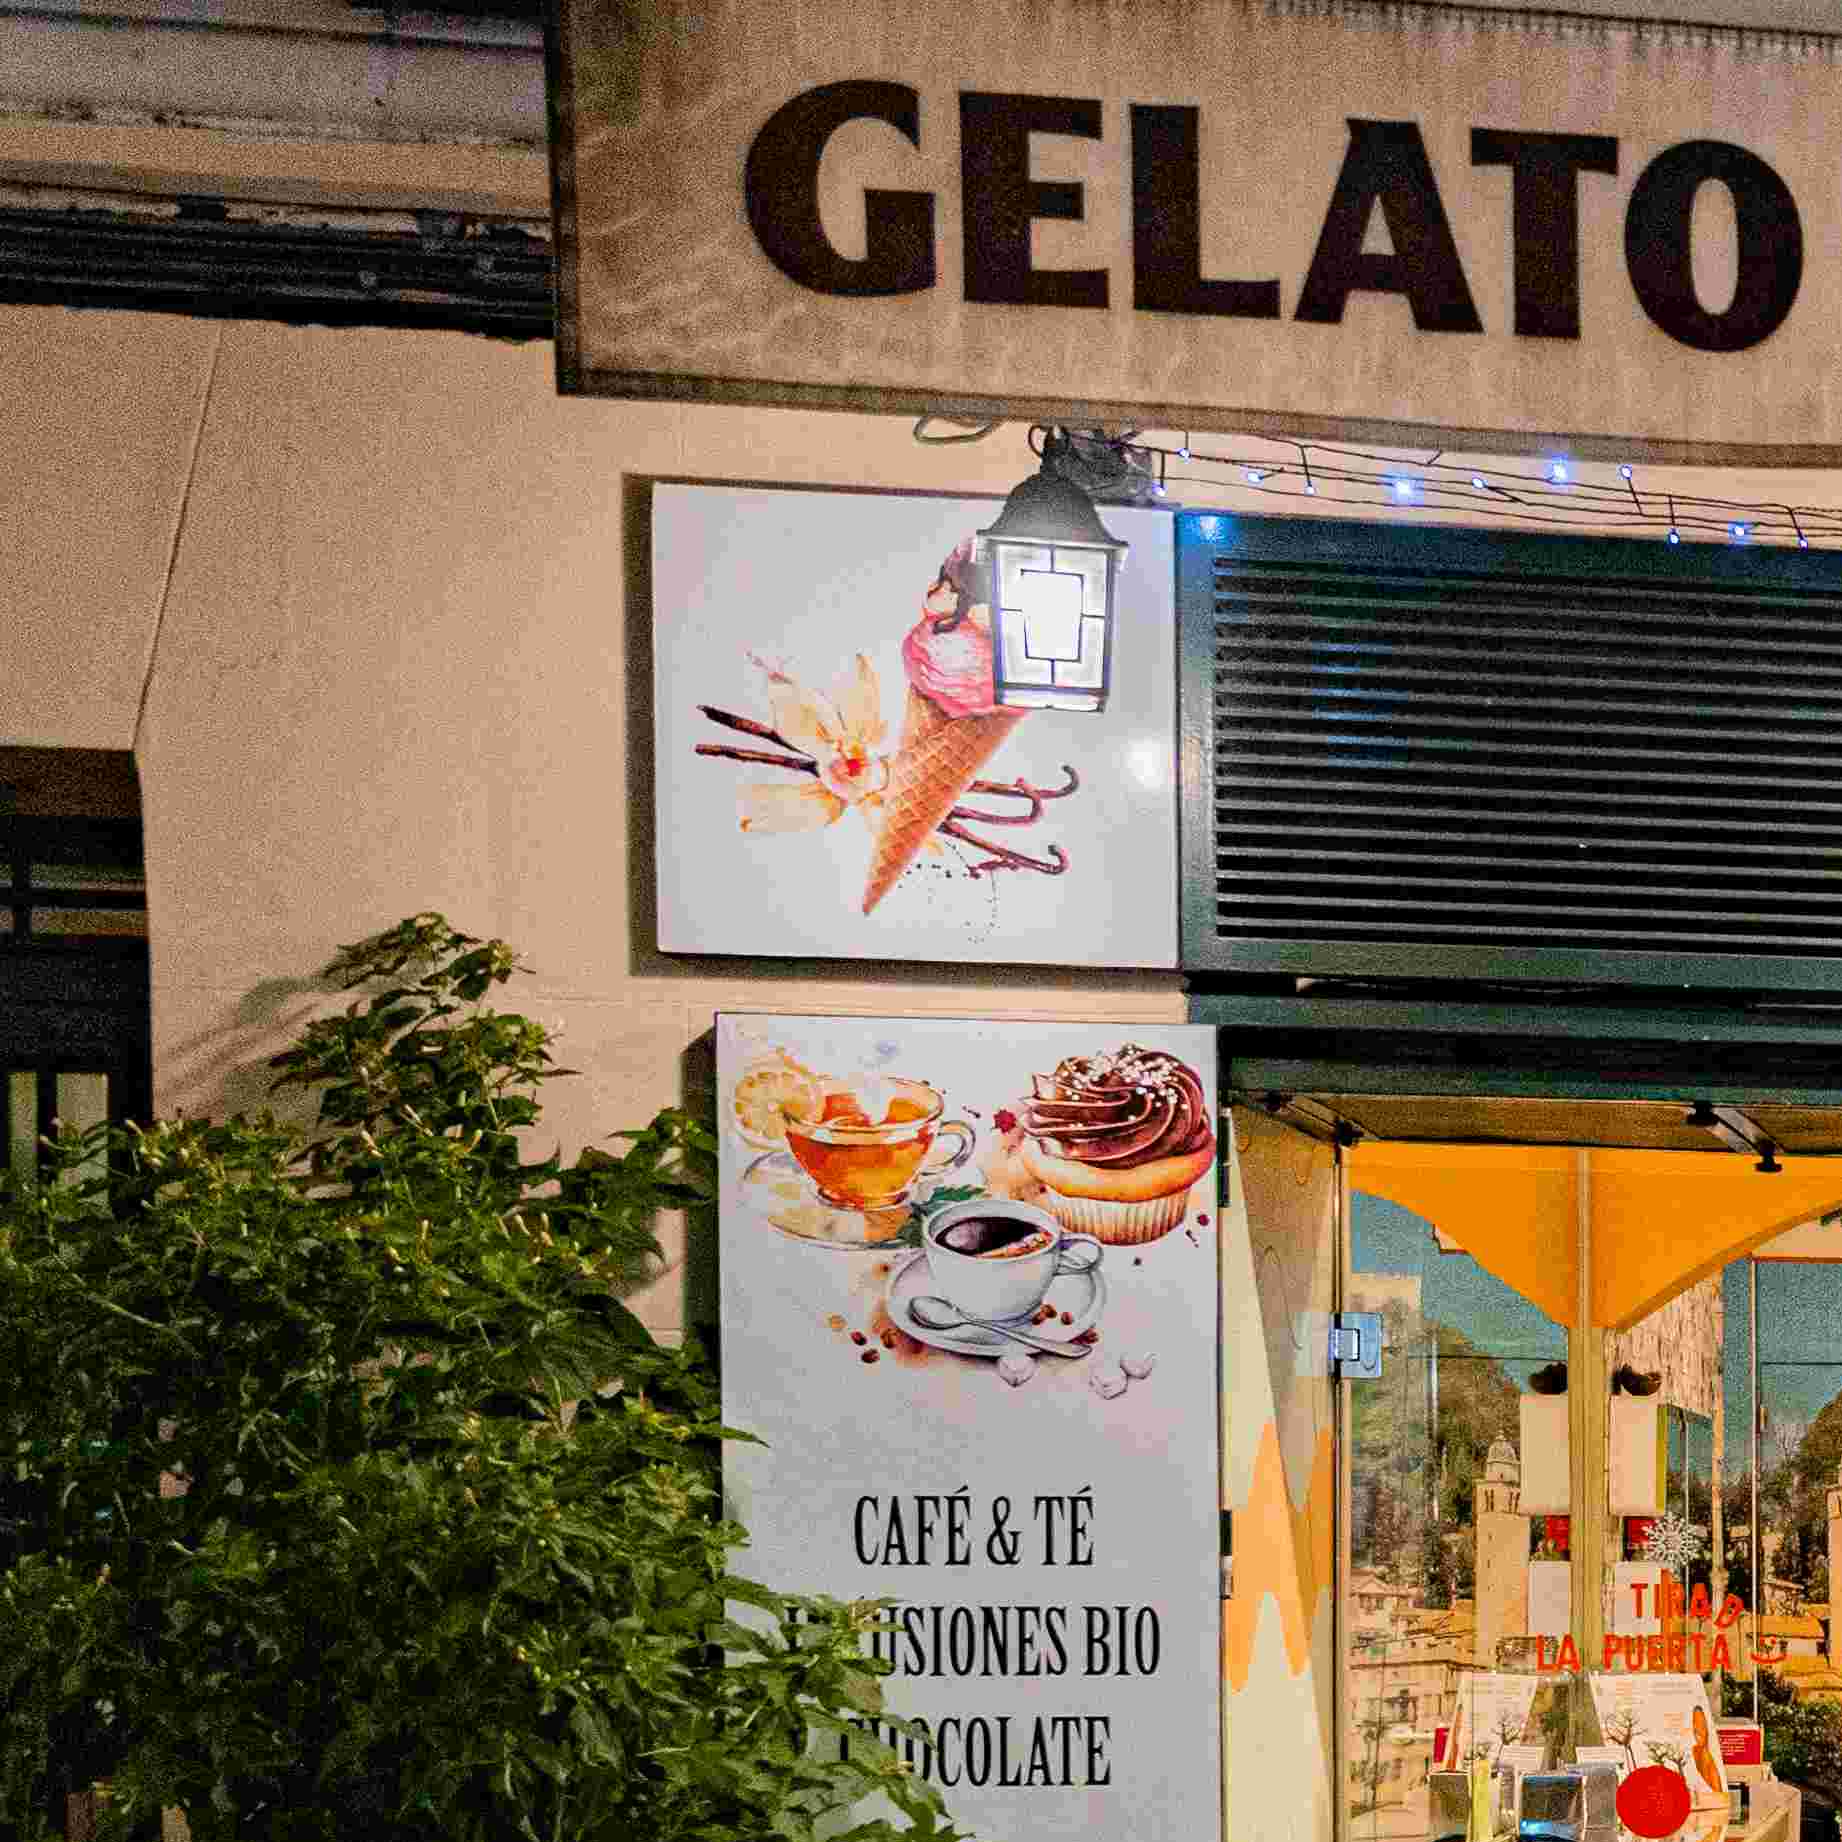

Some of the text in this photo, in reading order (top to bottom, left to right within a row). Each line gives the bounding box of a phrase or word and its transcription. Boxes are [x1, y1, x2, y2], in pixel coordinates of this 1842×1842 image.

[743, 79, 1804, 354] GELATO
[854, 1485, 1096, 1567] CAFÉ & TÉ
[1630, 1568, 1745, 1629] TIRAD
[786, 1605, 1161, 1677] USIONES BIO
[1536, 1634, 1731, 1673] LA PUERTA
